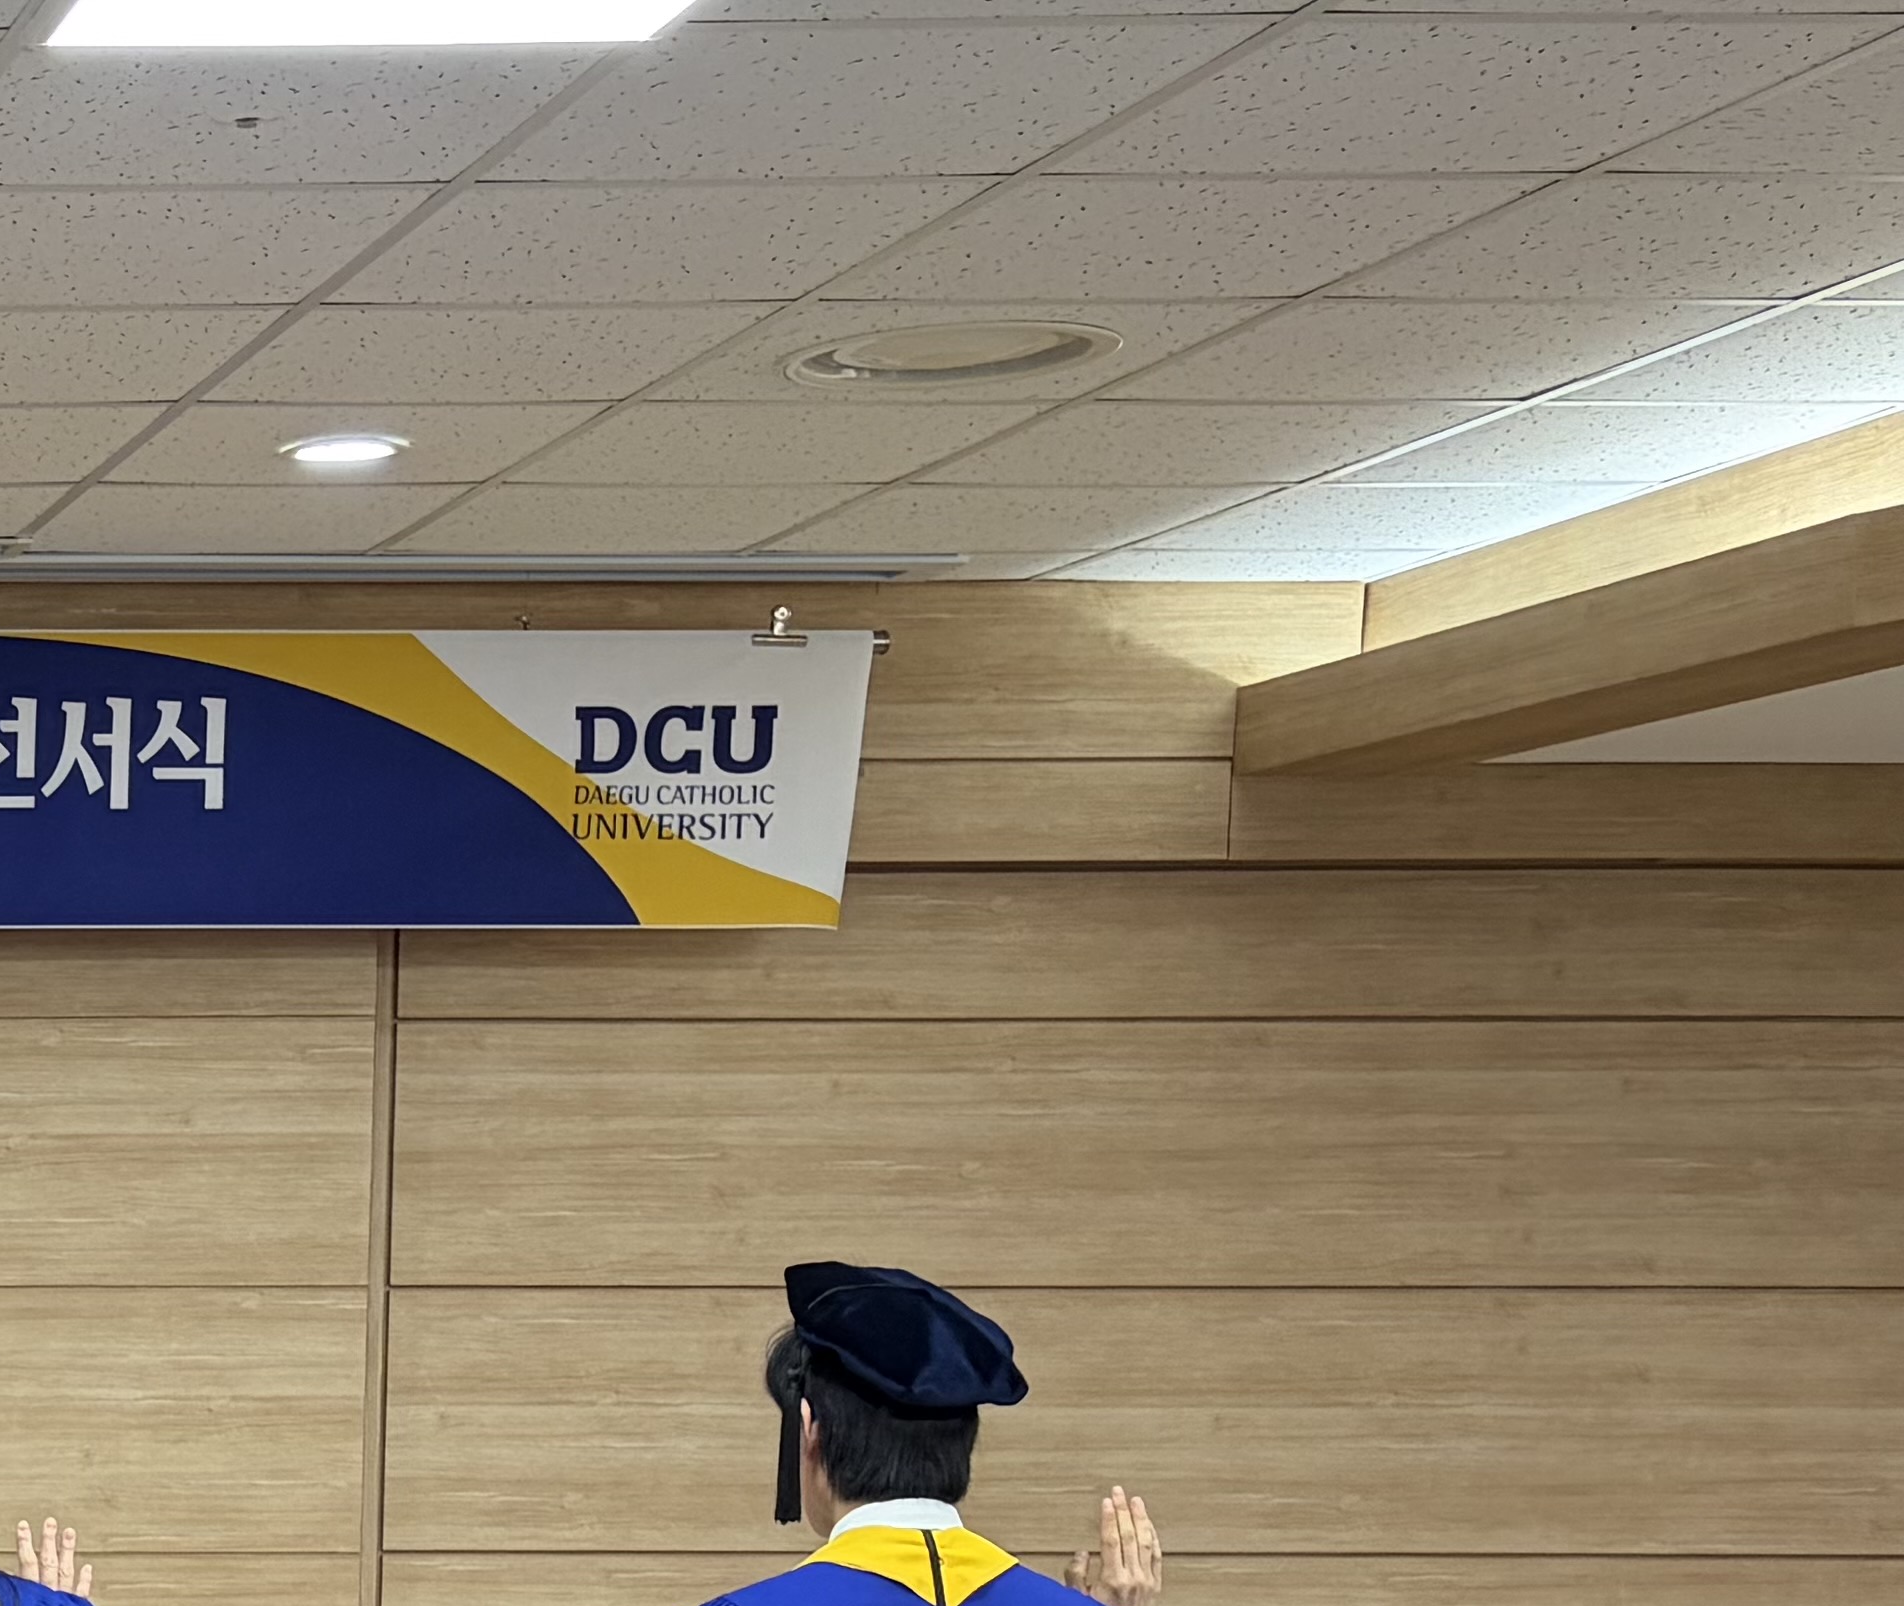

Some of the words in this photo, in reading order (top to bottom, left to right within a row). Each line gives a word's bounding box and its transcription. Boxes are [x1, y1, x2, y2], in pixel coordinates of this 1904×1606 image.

[575, 704, 779, 774] DCU
[574, 784, 650, 805] DAEGU
[656, 784, 775, 805] CATHOLIC
[572, 812, 775, 840] UNIVERSITY
